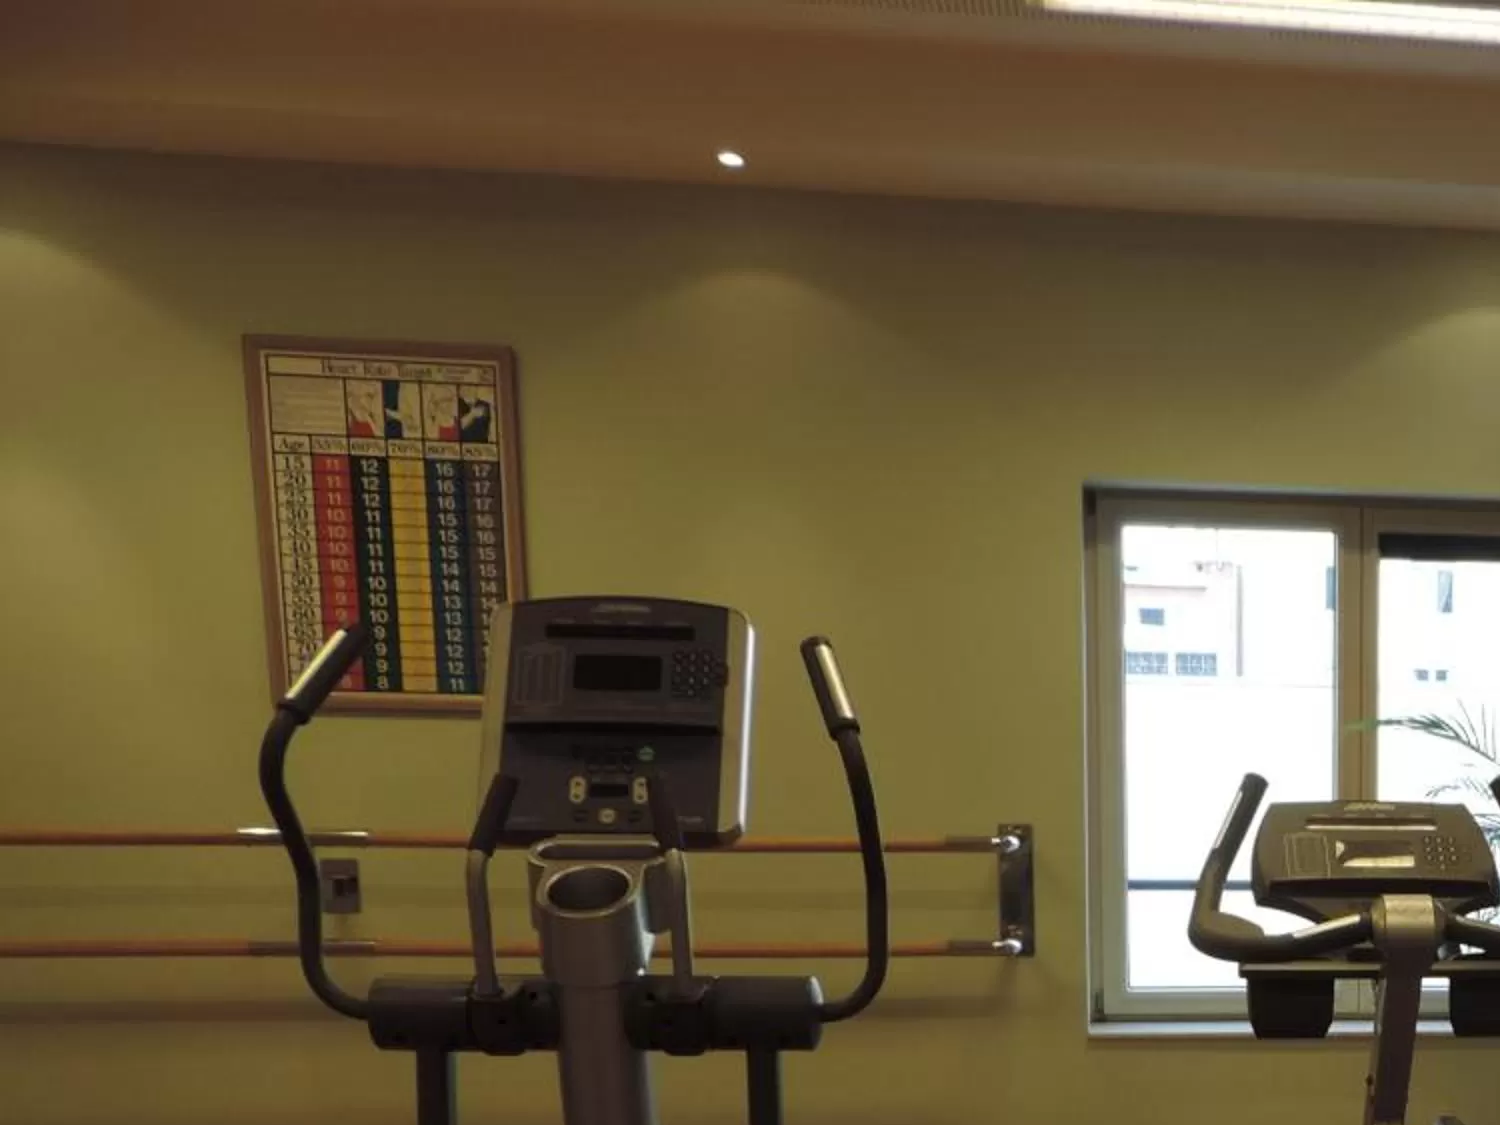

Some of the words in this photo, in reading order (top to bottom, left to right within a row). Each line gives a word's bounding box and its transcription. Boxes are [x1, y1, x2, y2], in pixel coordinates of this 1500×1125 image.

[278, 437, 304, 452] Age
[284, 455, 305, 470] 15
[326, 458, 339, 470] 11
[361, 459, 378, 473] 12
[436, 463, 453, 476] 16
[473, 464, 490, 477] 17
[327, 476, 341, 488] 11
[361, 477, 379, 490] 12
[438, 480, 454, 493] 16
[475, 481, 490, 494] 17
[328, 492, 340, 504] 11
[364, 494, 379, 507] 12
[476, 498, 491, 510] 17
[328, 509, 345, 522] 10
[367, 510, 380, 522] 11
[439, 513, 456, 526] 15
[328, 526, 346, 539] 10
[368, 526, 381, 540] 11
[440, 530, 458, 542] 15
[329, 542, 348, 555] 10
[368, 544, 382, 556] 11
[441, 546, 458, 559] 15
[370, 560, 383, 573] 11
[442, 563, 459, 575] 14
[368, 576, 386, 590] 10
[443, 580, 459, 592] 14
[370, 593, 387, 606] 10
[444, 595, 461, 609] 13
[370, 610, 388, 623] 10
[445, 612, 461, 625] 13
[446, 628, 461, 641] 12
[375, 642, 387, 656] 9
[446, 644, 463, 658] 12
[448, 662, 464, 674] 12
[451, 678, 464, 690] 11
